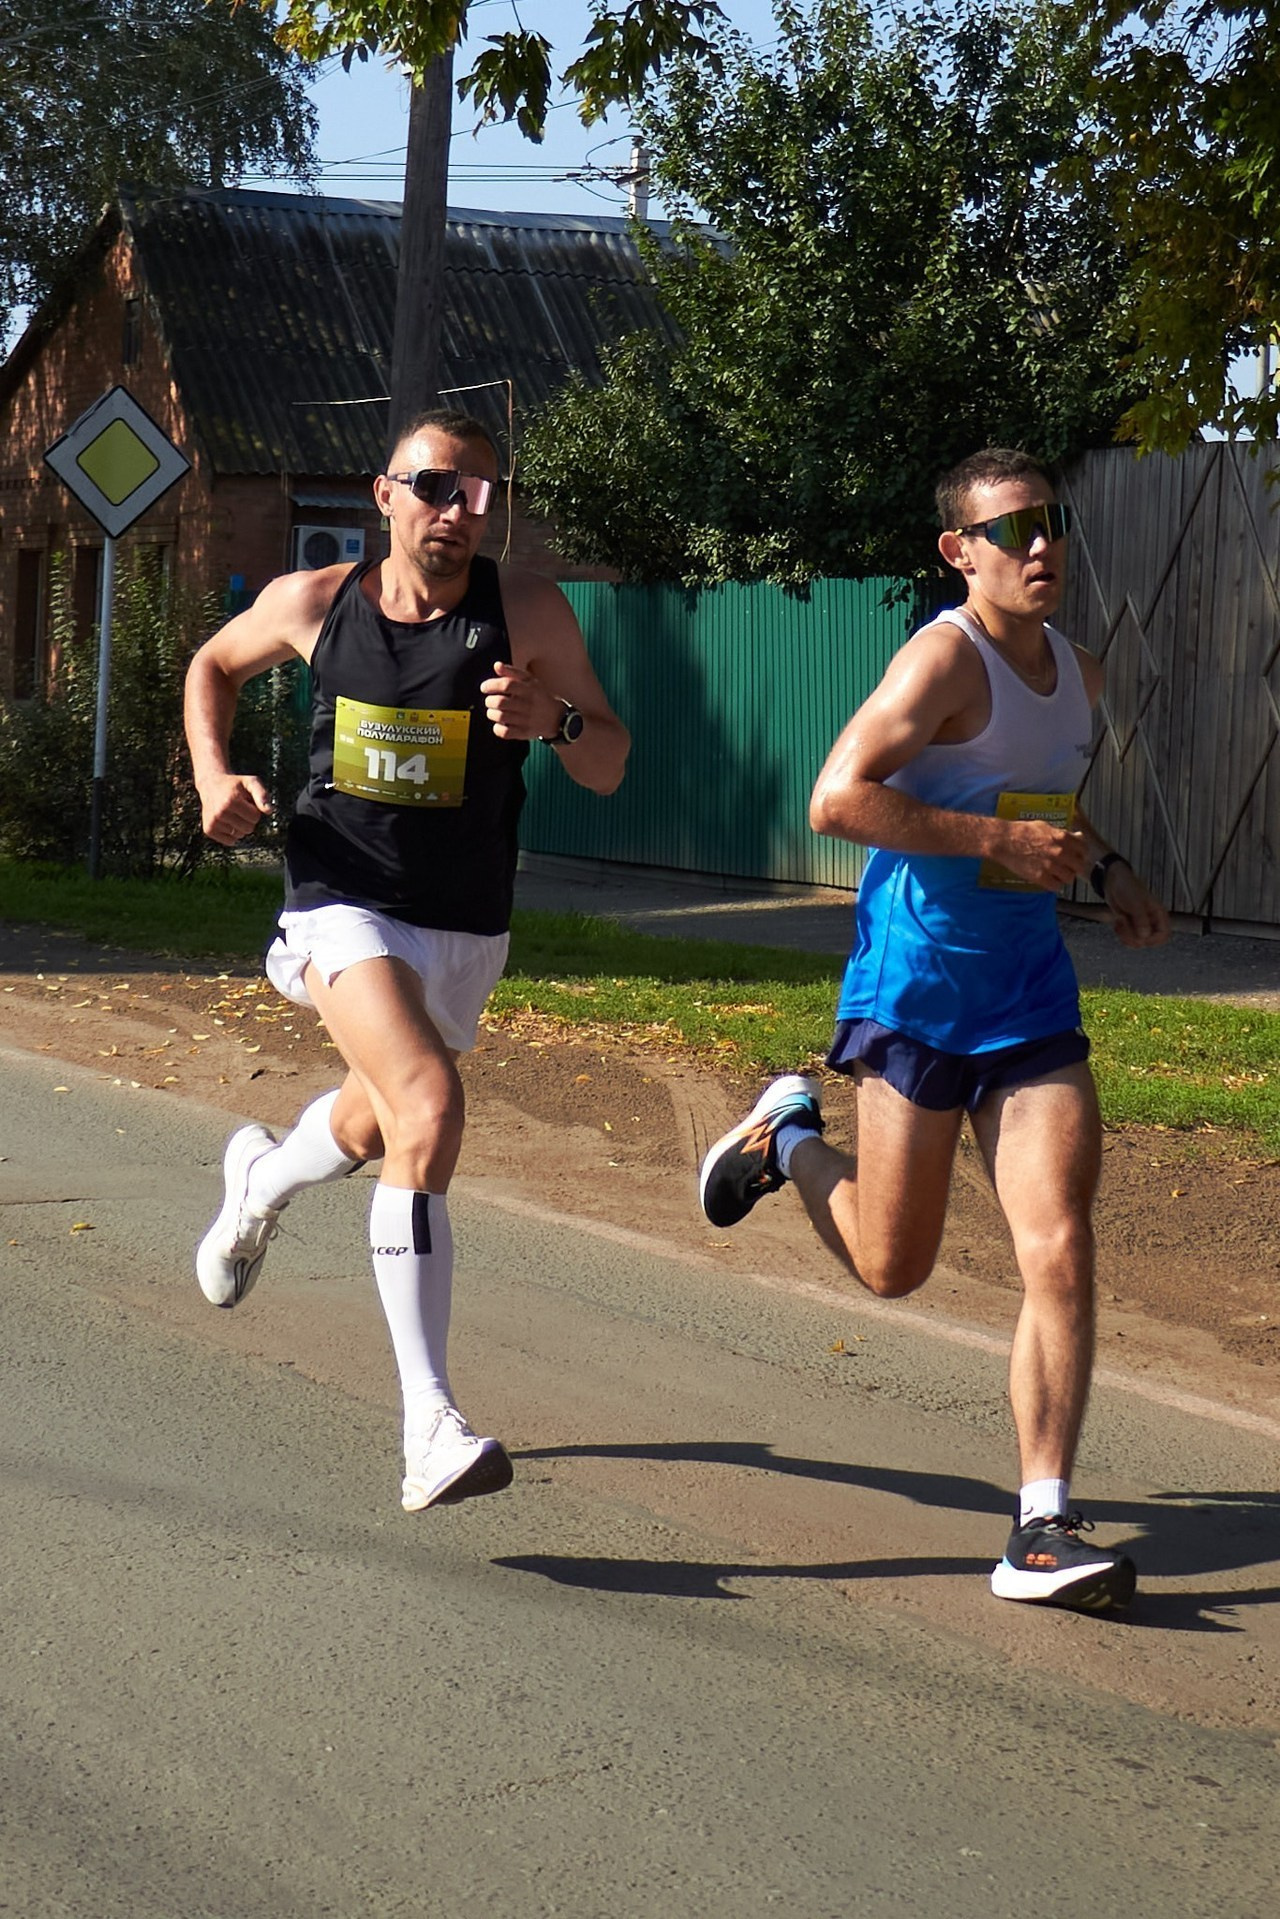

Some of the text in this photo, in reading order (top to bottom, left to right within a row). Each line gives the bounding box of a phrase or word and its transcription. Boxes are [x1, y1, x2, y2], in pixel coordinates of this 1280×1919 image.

[360, 719, 441, 735] БУЗУЛУКСКИЙ
[357, 727, 443, 744] ПОЛУМАРАФОН
[364, 747, 430, 785] 114
[377, 1246, 409, 1256] cep
